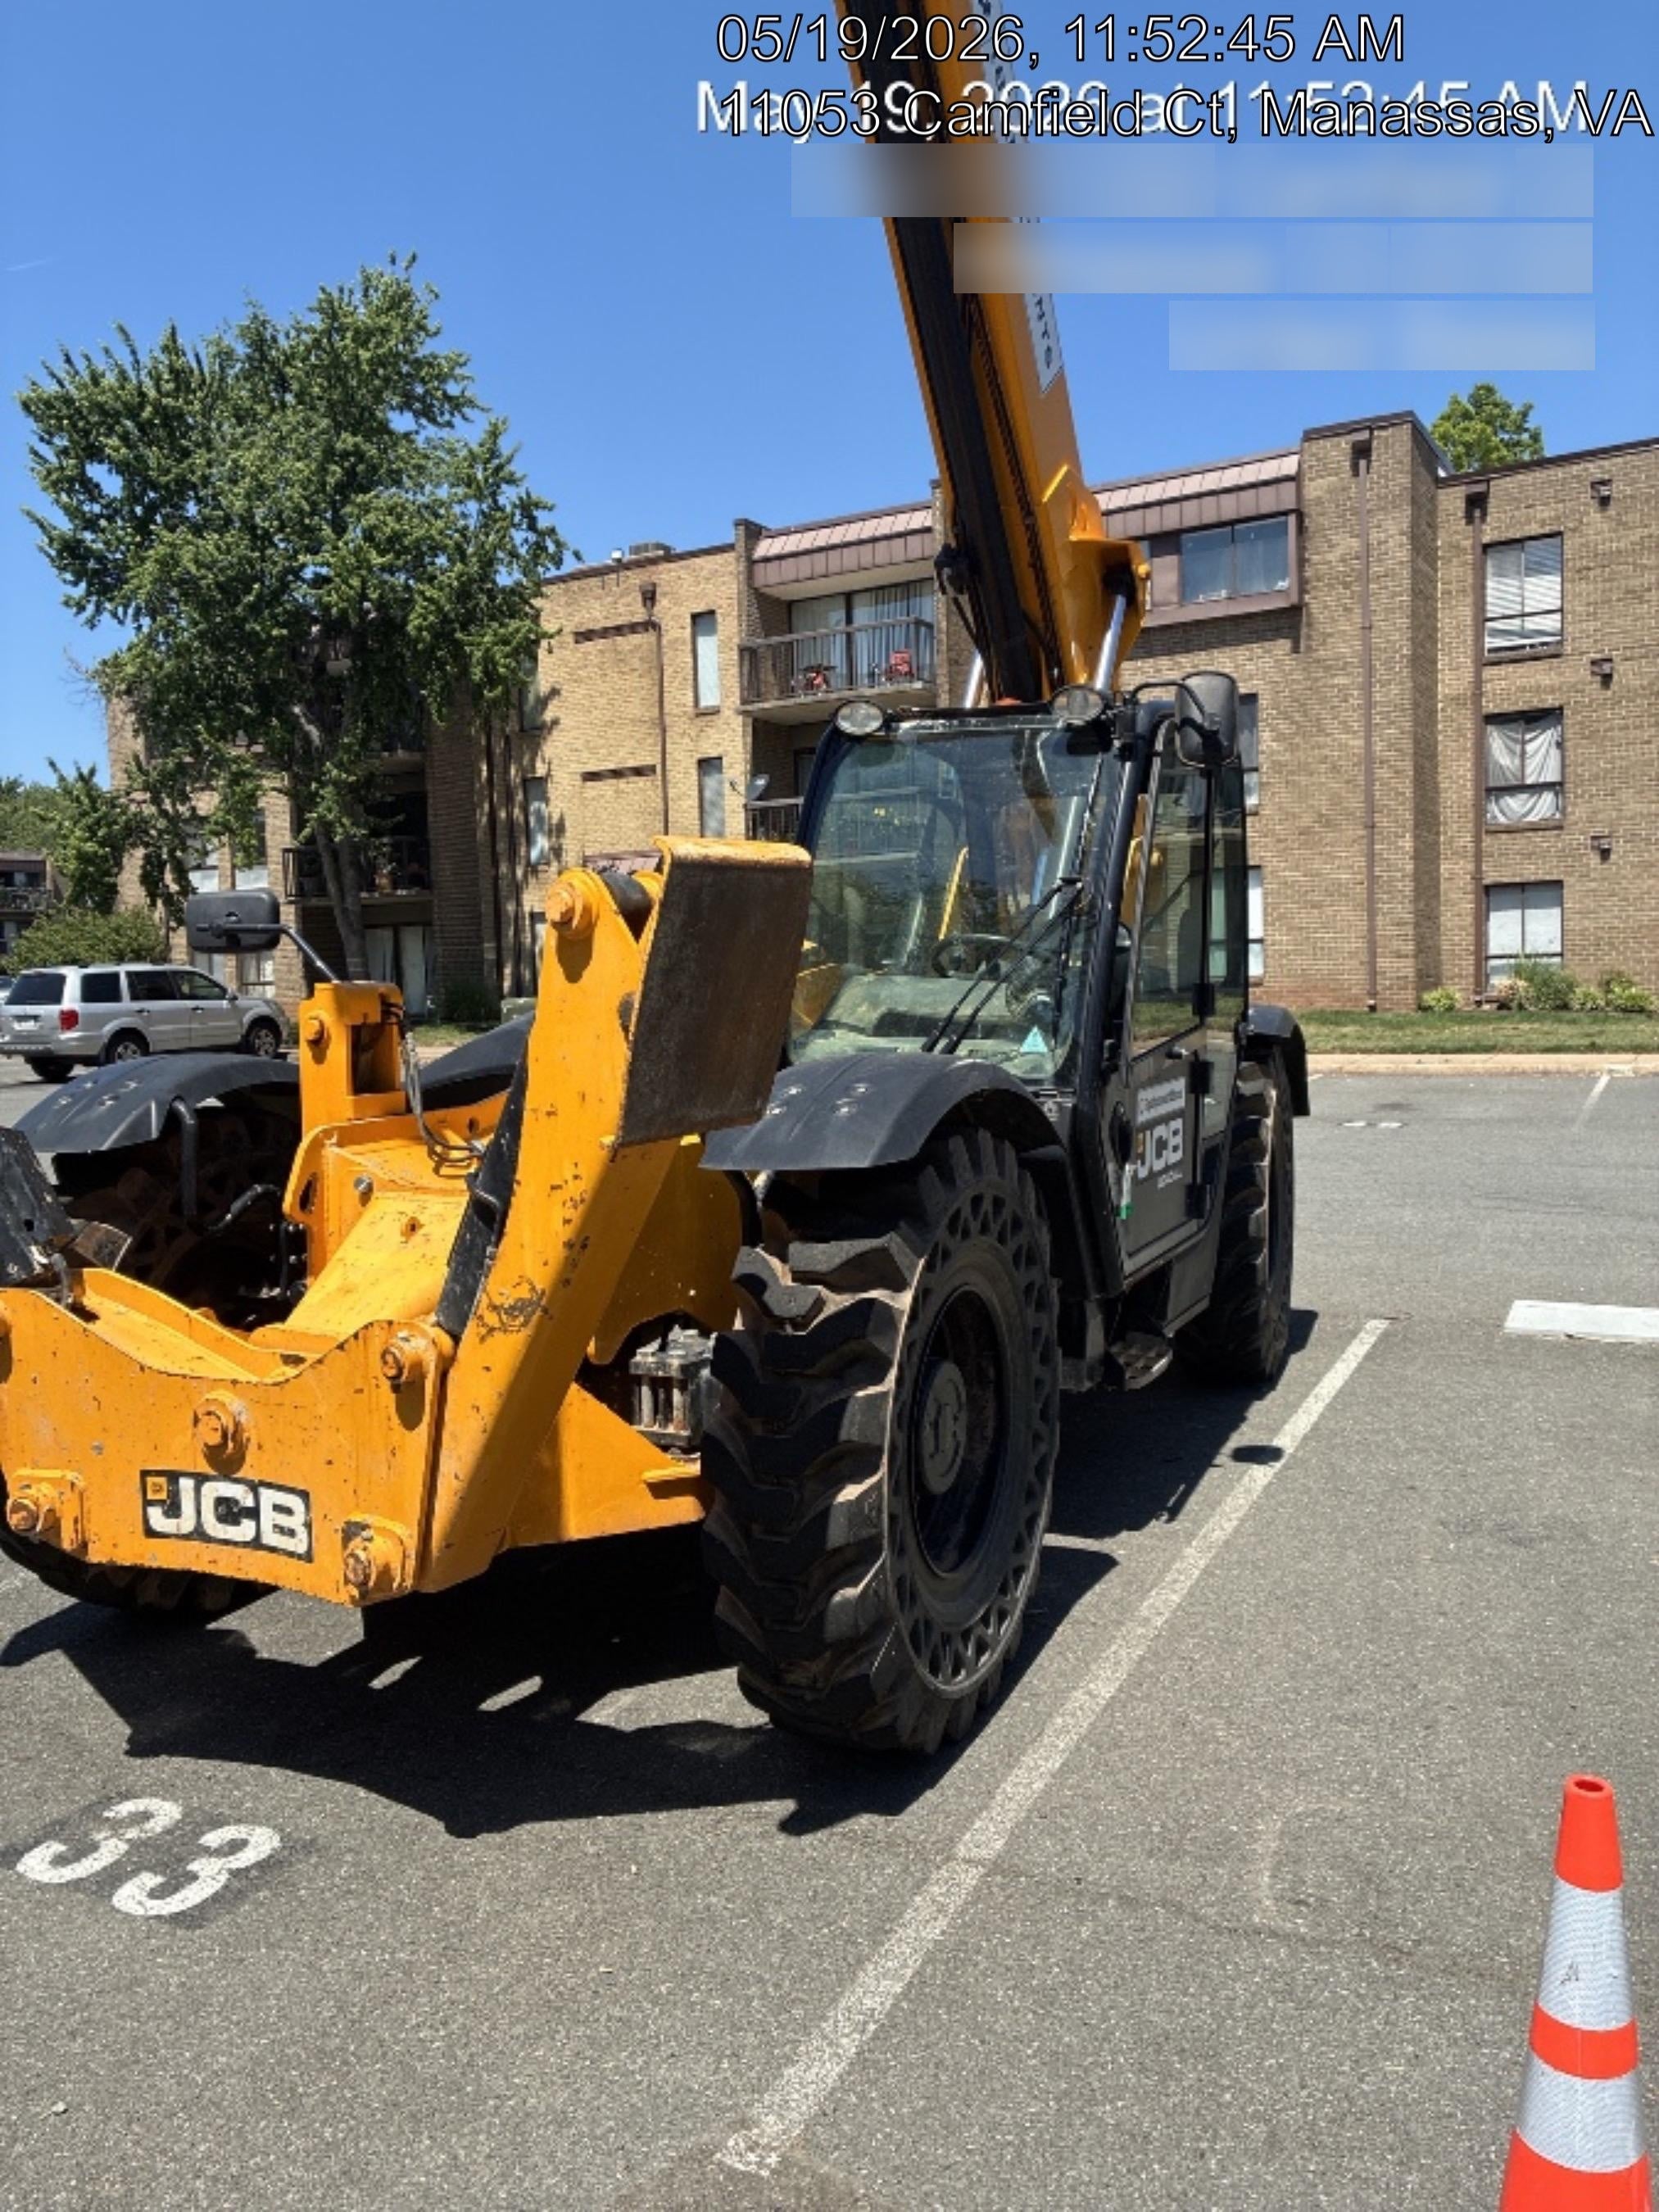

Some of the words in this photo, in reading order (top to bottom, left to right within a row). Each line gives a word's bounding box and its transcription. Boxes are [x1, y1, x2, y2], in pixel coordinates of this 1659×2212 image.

[1137, 1117, 1183, 1180] JCB
[147, 1476, 309, 1555] JCB
[16, 1799, 281, 1915] 33
